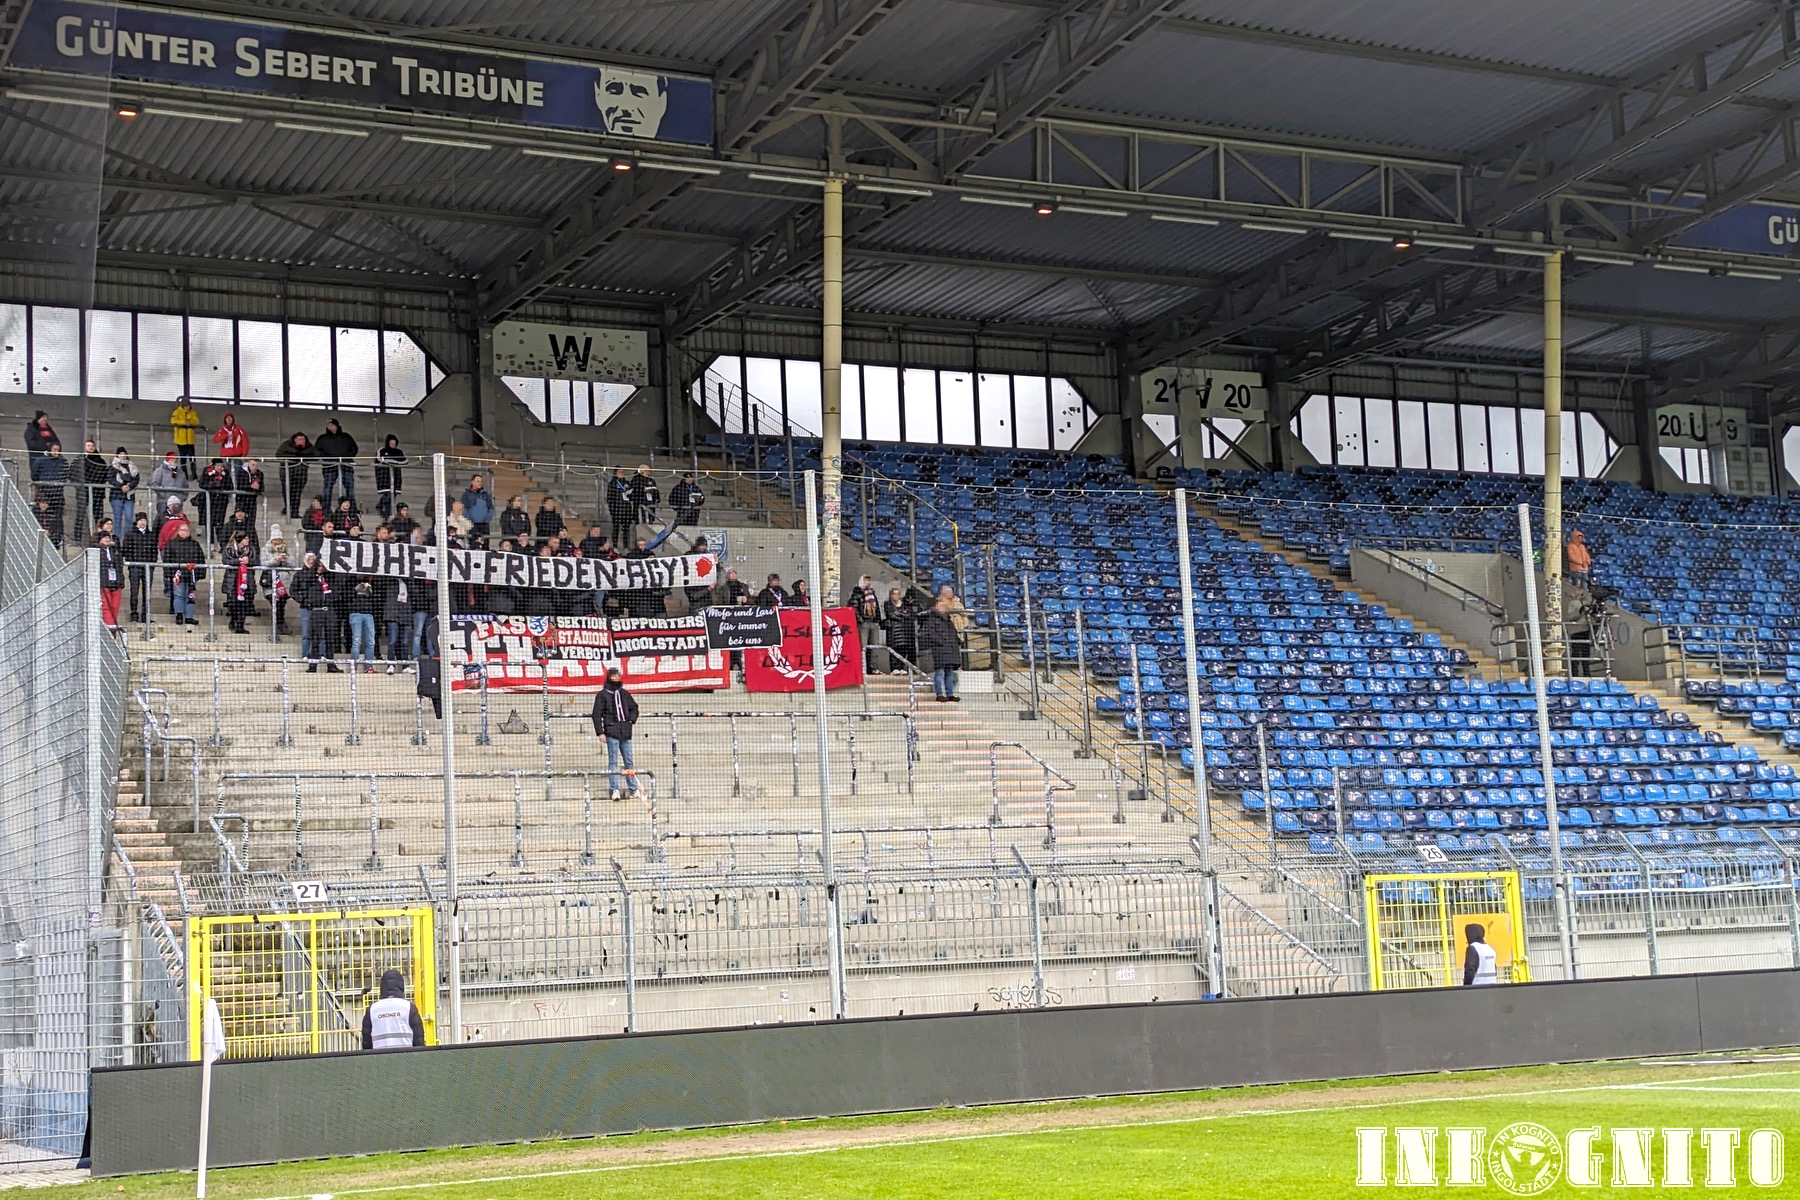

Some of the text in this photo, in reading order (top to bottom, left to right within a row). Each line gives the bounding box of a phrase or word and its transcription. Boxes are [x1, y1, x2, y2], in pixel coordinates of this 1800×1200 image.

[55, 15, 545, 108] GÜNTER SEBERT TRIBÜNE
[548, 333, 593, 372] W
[1223, 383, 1251, 409] 20
[1658, 414, 1681, 437] 20
[329, 540, 427, 580] RUHE
[484, 551, 618, 589] FRIEDEN
[734, 607, 754, 617] und
[755, 606, 775, 618] Lars
[557, 616, 608, 630] SEKTION
[611, 615, 705, 632] SUPPORTERS
[718, 621, 768, 635] für immer
[557, 630, 609, 646] STADION
[614, 635, 707, 653] INGOLSTADT
[728, 636, 763, 645] bei uns
[560, 645, 610, 660] VERBOT
[1422, 848, 1444, 860] 26
[297, 884, 320, 899] 27
